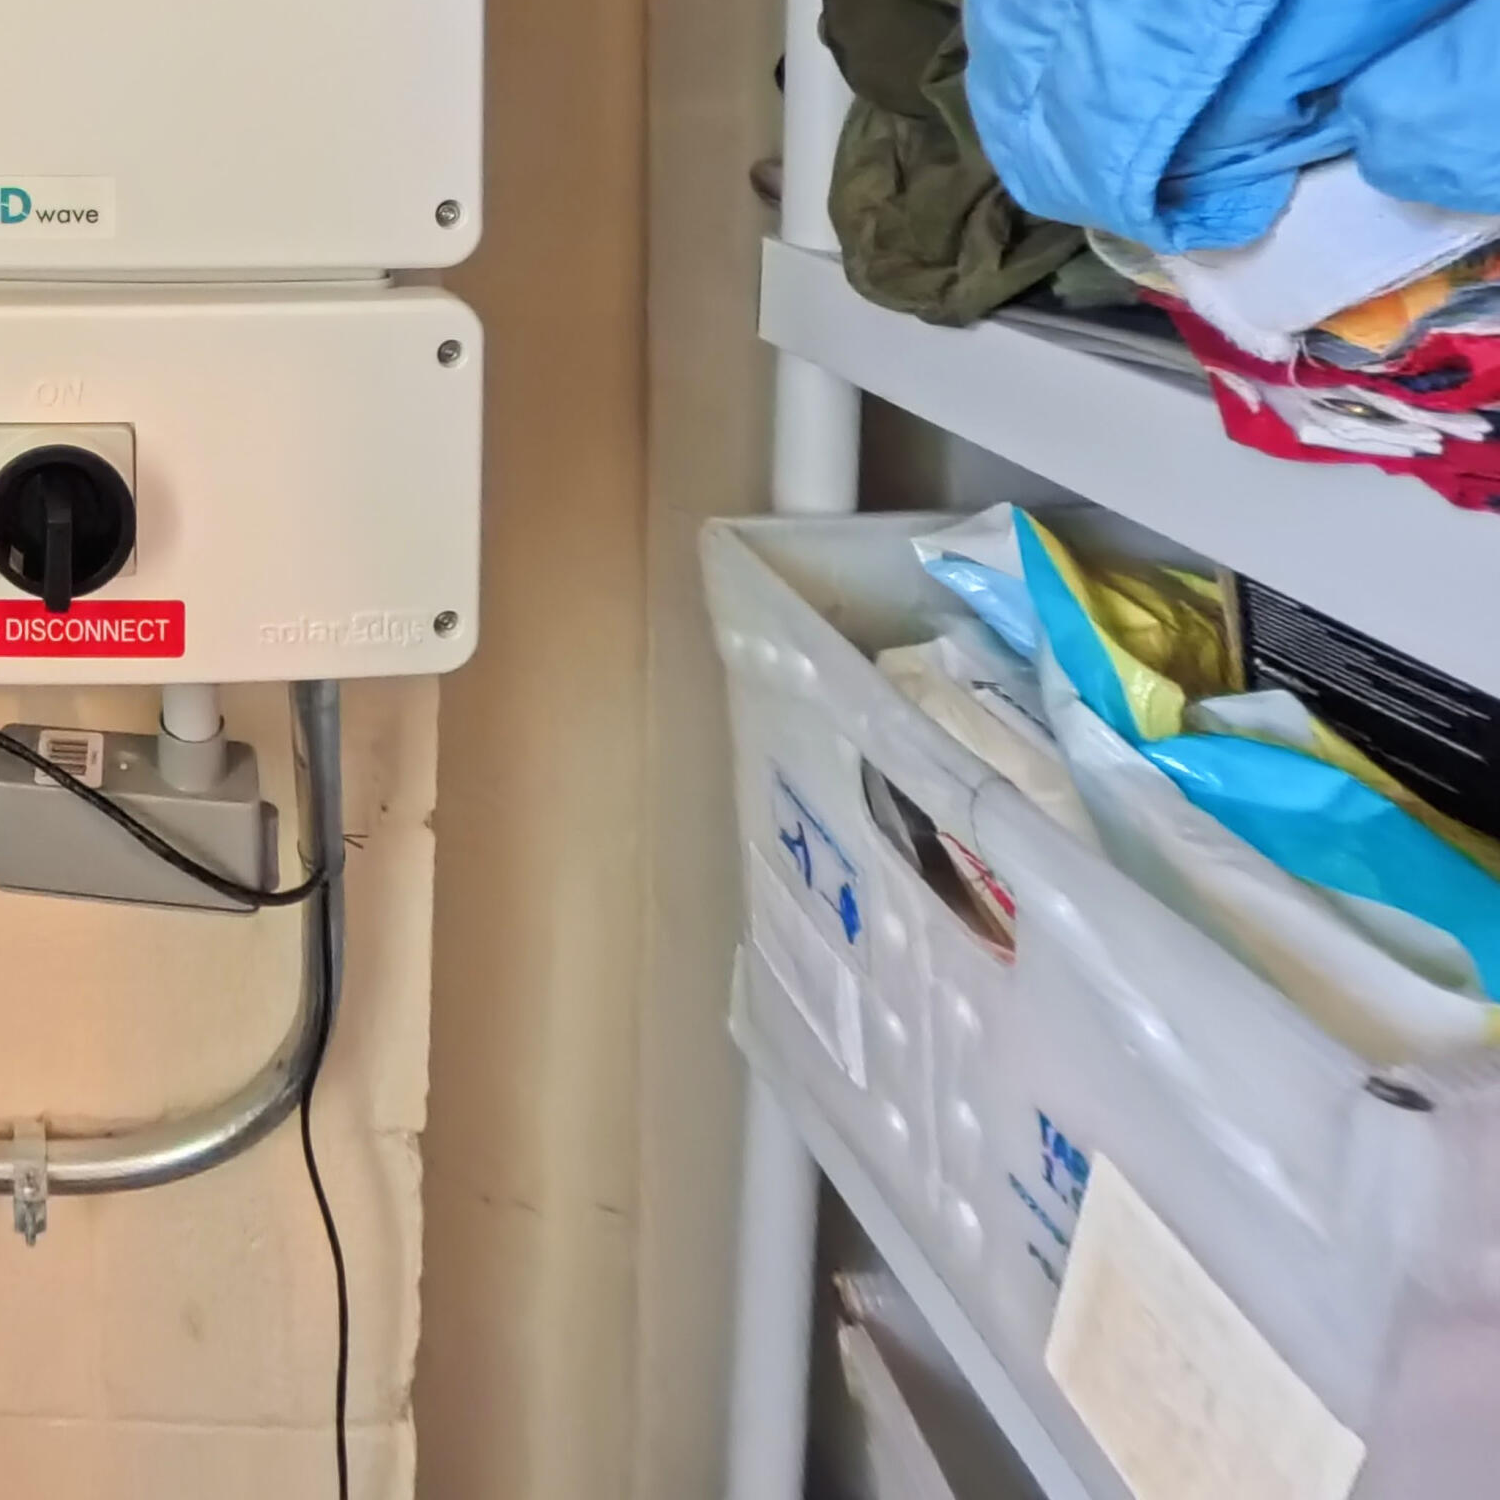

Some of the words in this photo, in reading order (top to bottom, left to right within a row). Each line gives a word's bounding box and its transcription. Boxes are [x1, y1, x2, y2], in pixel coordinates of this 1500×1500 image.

[36, 208, 100, 224] wave
[35, 378, 85, 409] ON
[5, 618, 170, 642] DISCONNECT
